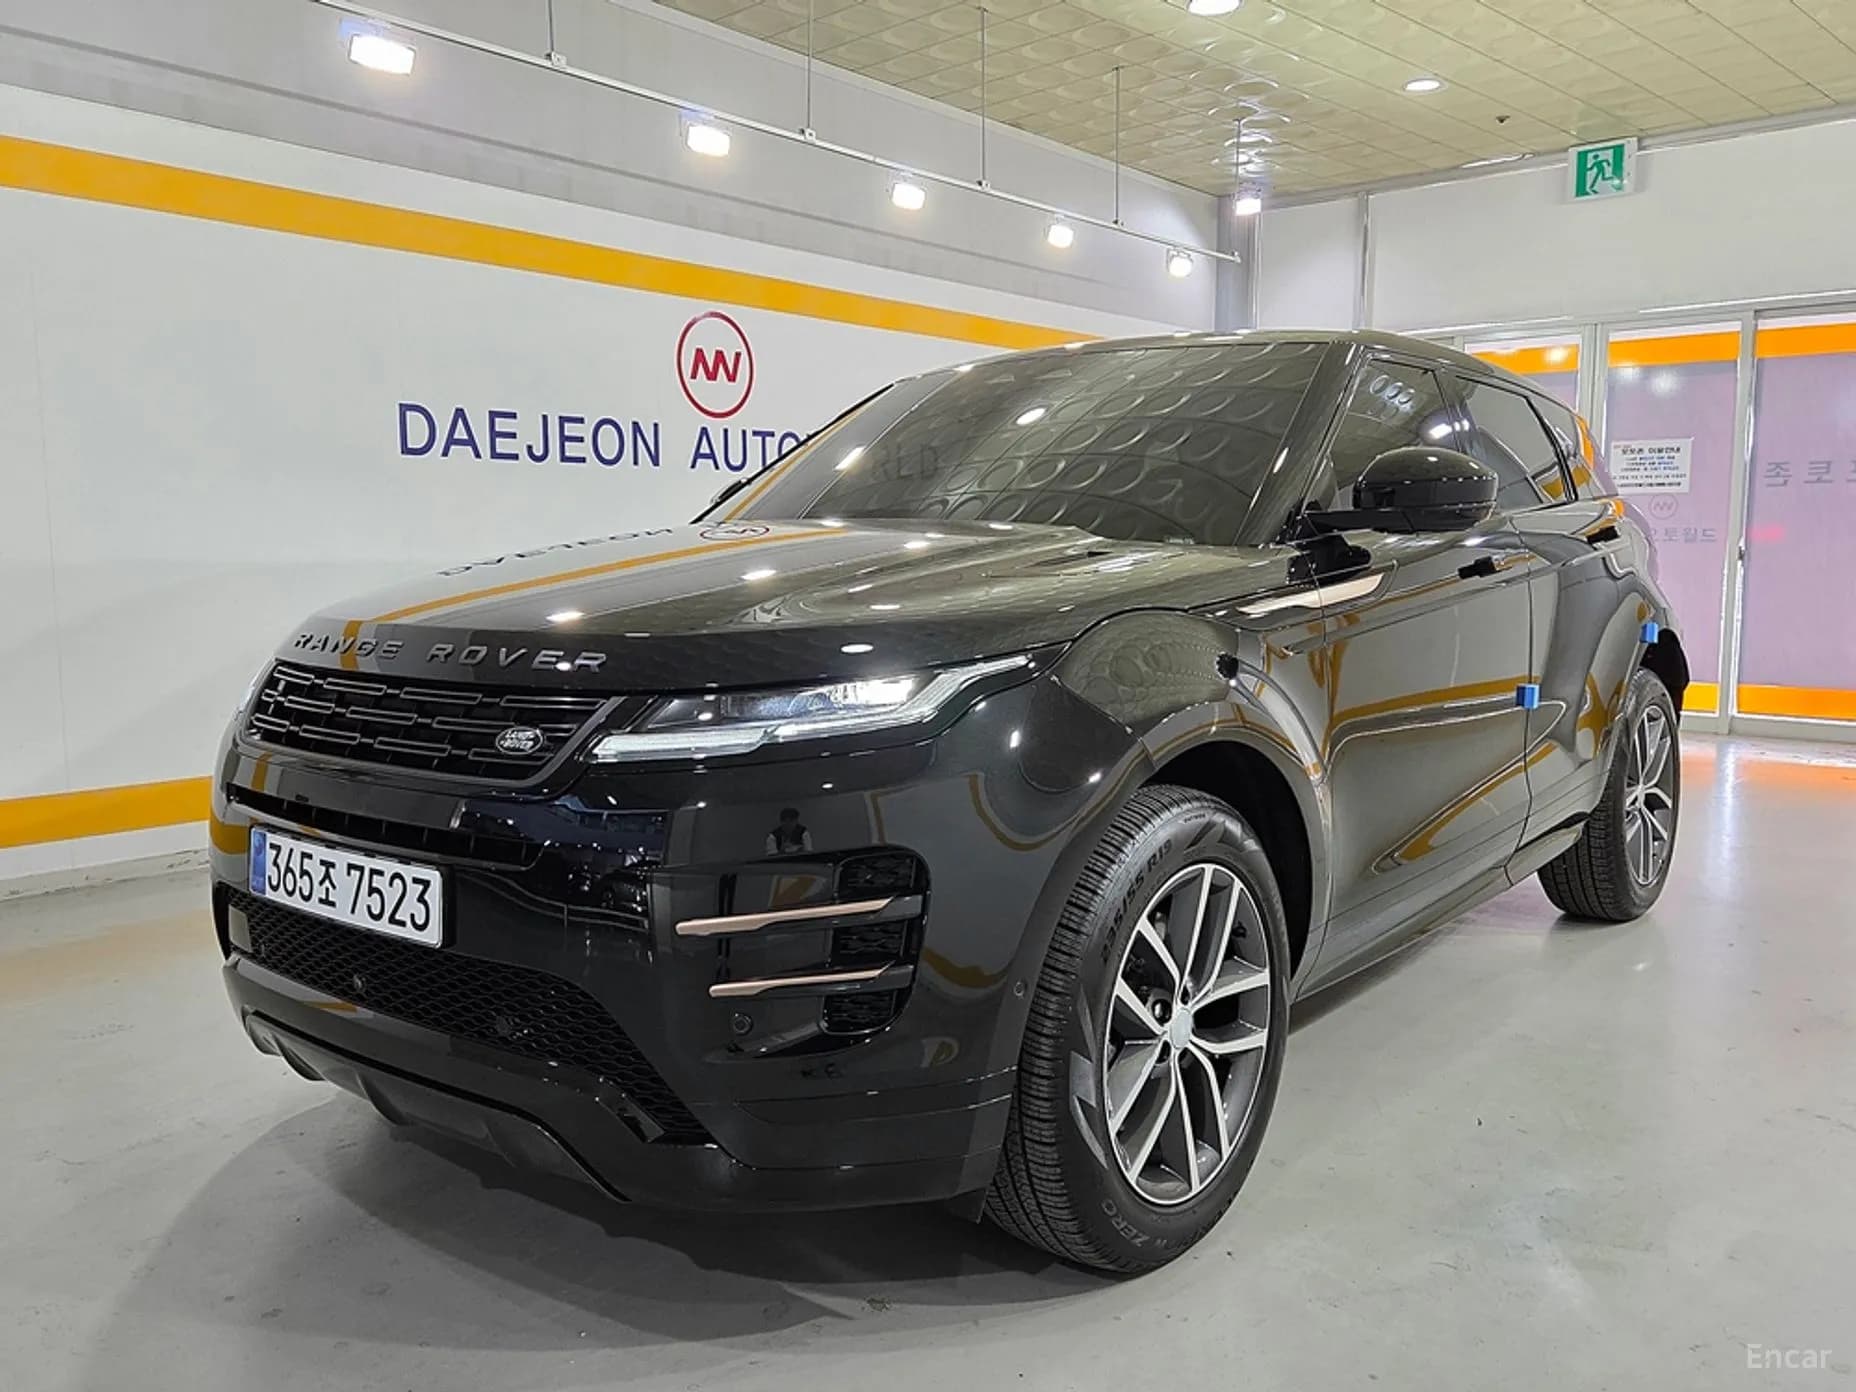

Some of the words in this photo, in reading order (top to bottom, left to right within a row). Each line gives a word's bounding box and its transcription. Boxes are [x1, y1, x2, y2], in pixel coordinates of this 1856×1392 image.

[397, 402, 662, 468] DAEJEON
[293, 631, 403, 661] RANGE
[426, 643, 609, 673] ROVER
[267, 843, 337, 908] 365조
[346, 863, 432, 933] 7523
